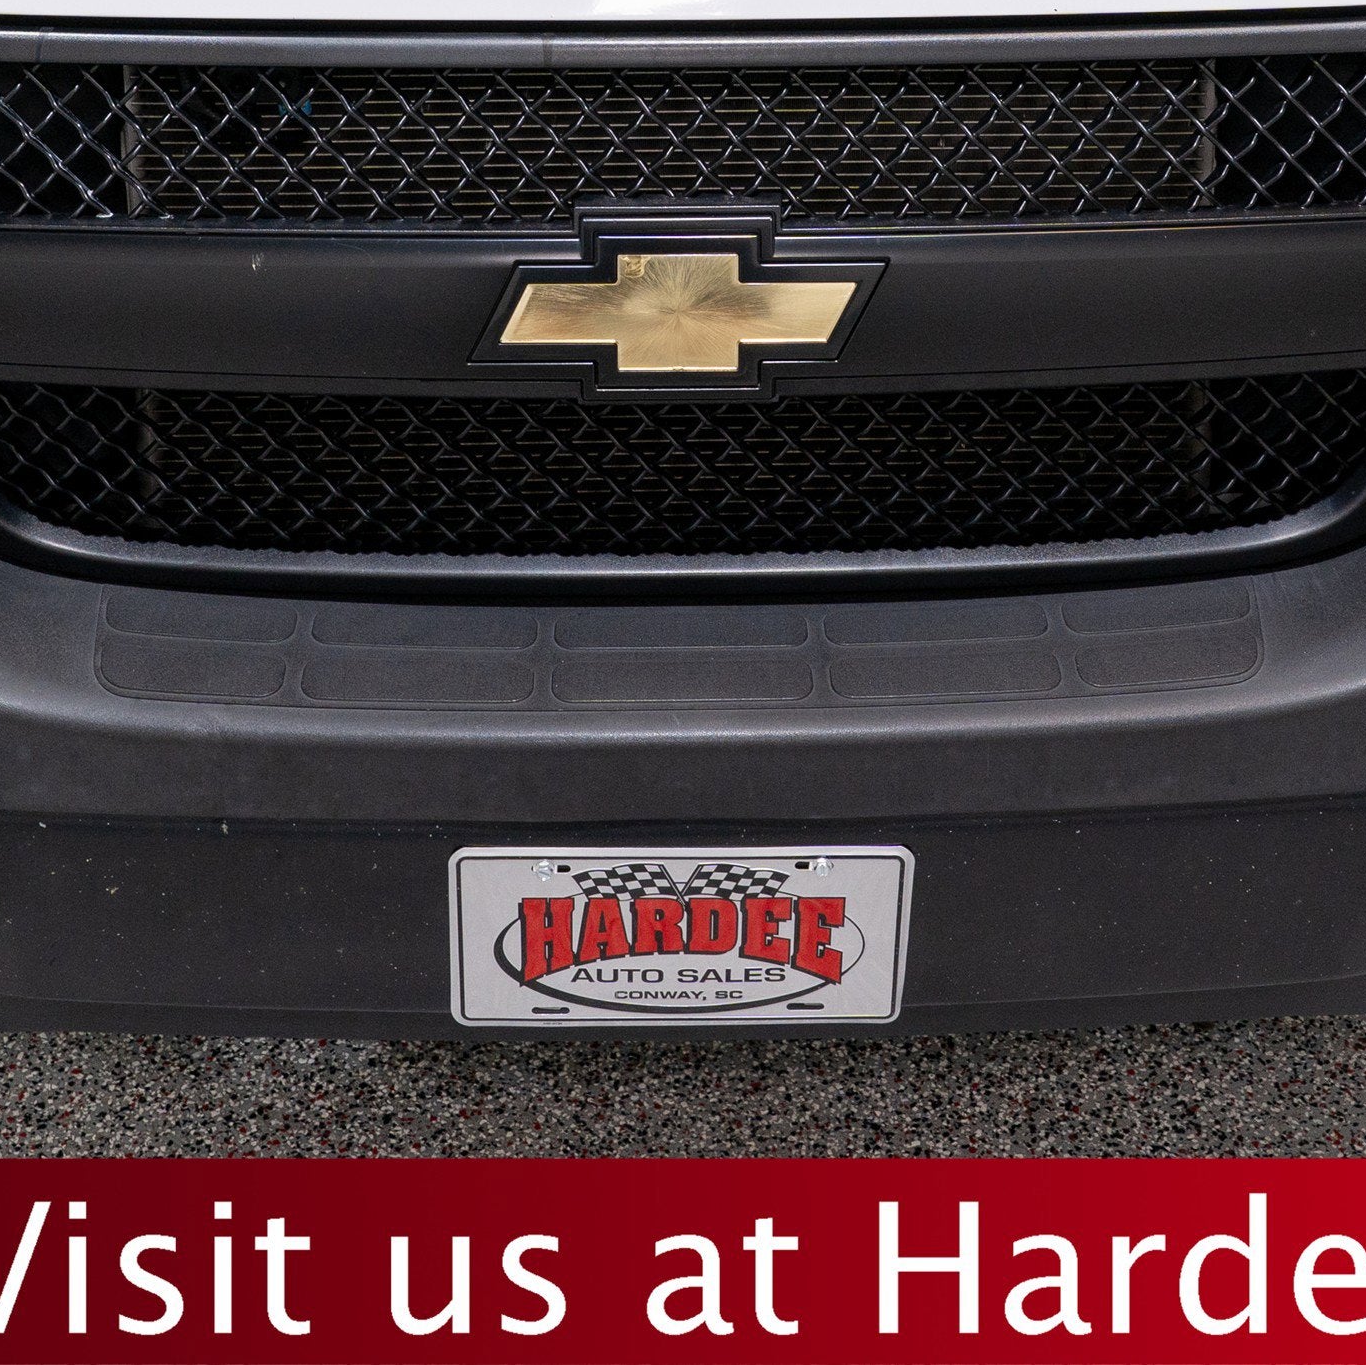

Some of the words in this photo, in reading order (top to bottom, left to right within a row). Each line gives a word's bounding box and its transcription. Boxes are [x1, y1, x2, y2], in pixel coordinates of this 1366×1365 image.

[518, 896, 846, 985] HARDEE
[570, 968, 664, 983] AUTO
[677, 967, 786, 983] SALES
[614, 990, 707, 1001] CONWAY,
[714, 990, 744, 1000] SC
